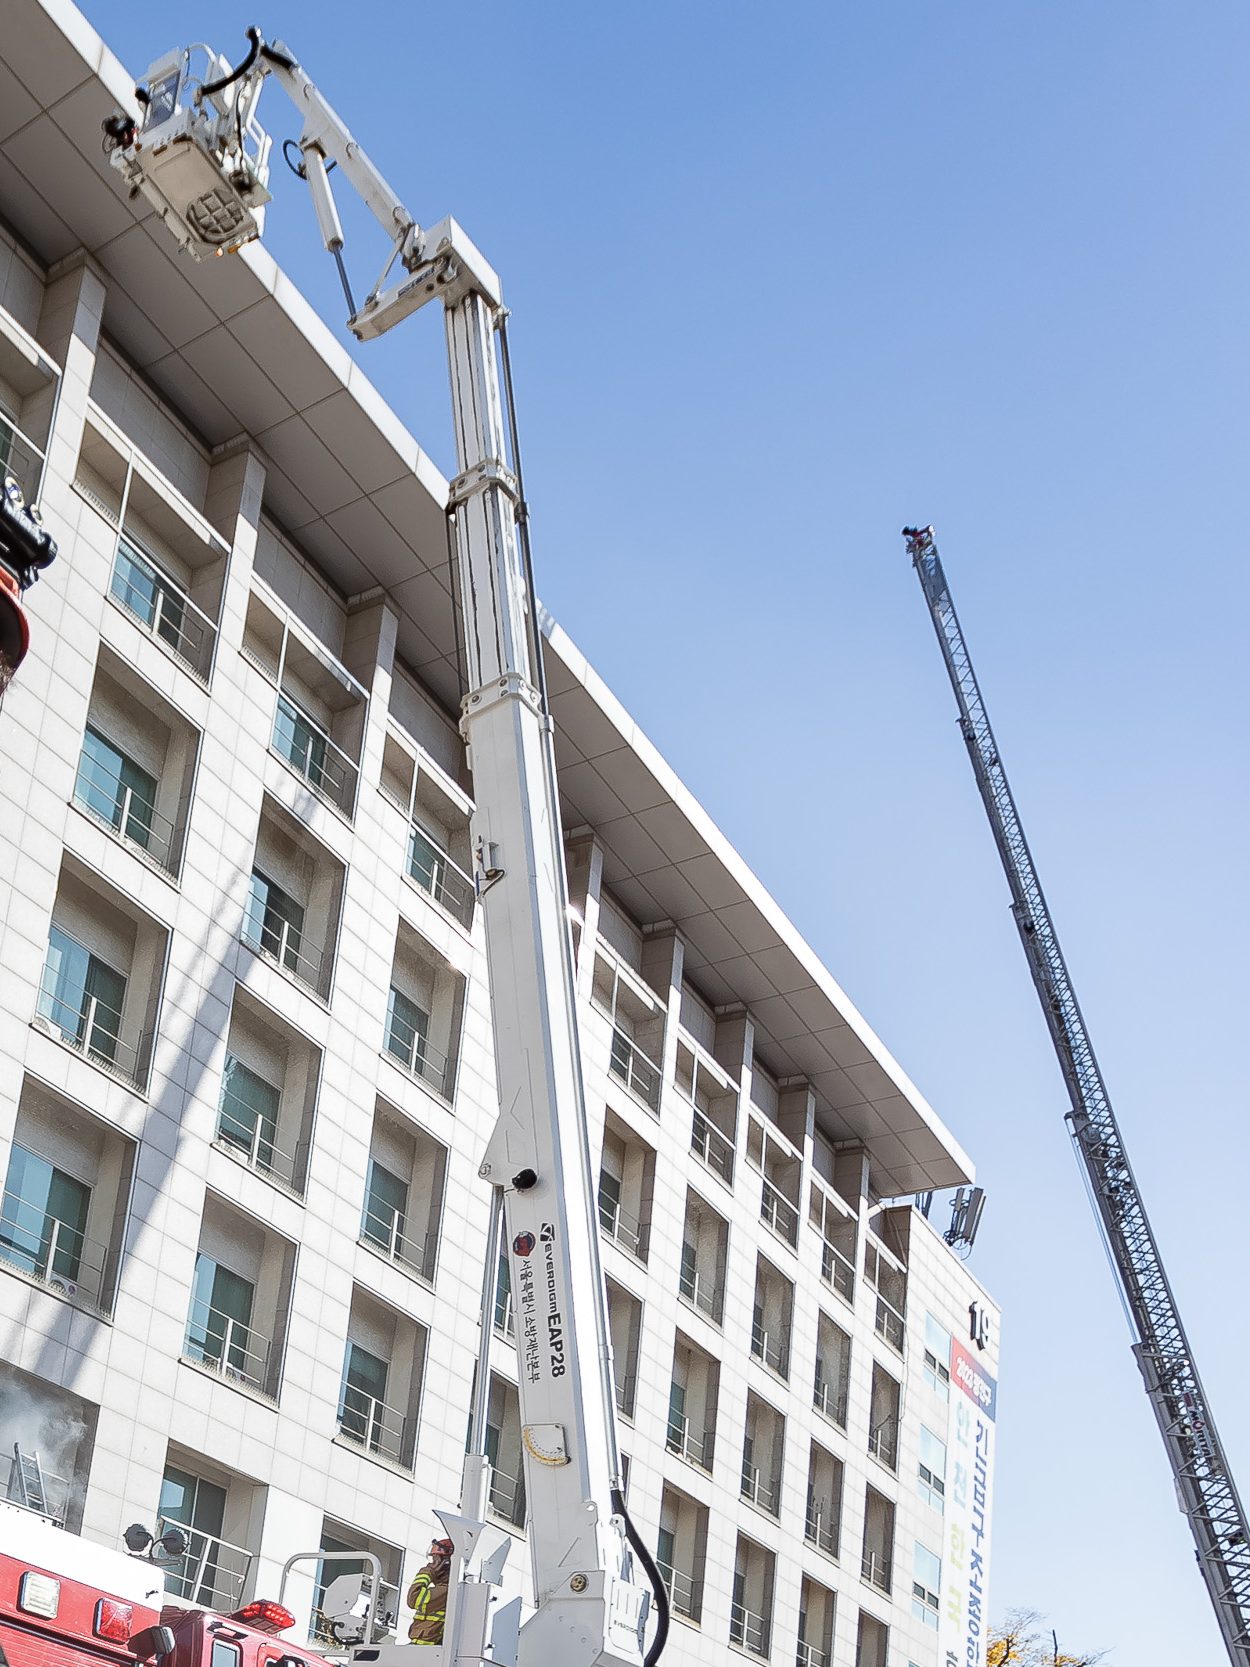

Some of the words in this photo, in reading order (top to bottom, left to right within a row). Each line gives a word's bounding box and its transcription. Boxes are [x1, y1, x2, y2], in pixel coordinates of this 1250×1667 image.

[520, 1259, 535, 1315] 서울특별시
[524, 1317, 541, 1383] 소방재난본부
[548, 1313, 566, 1378] EAP28
